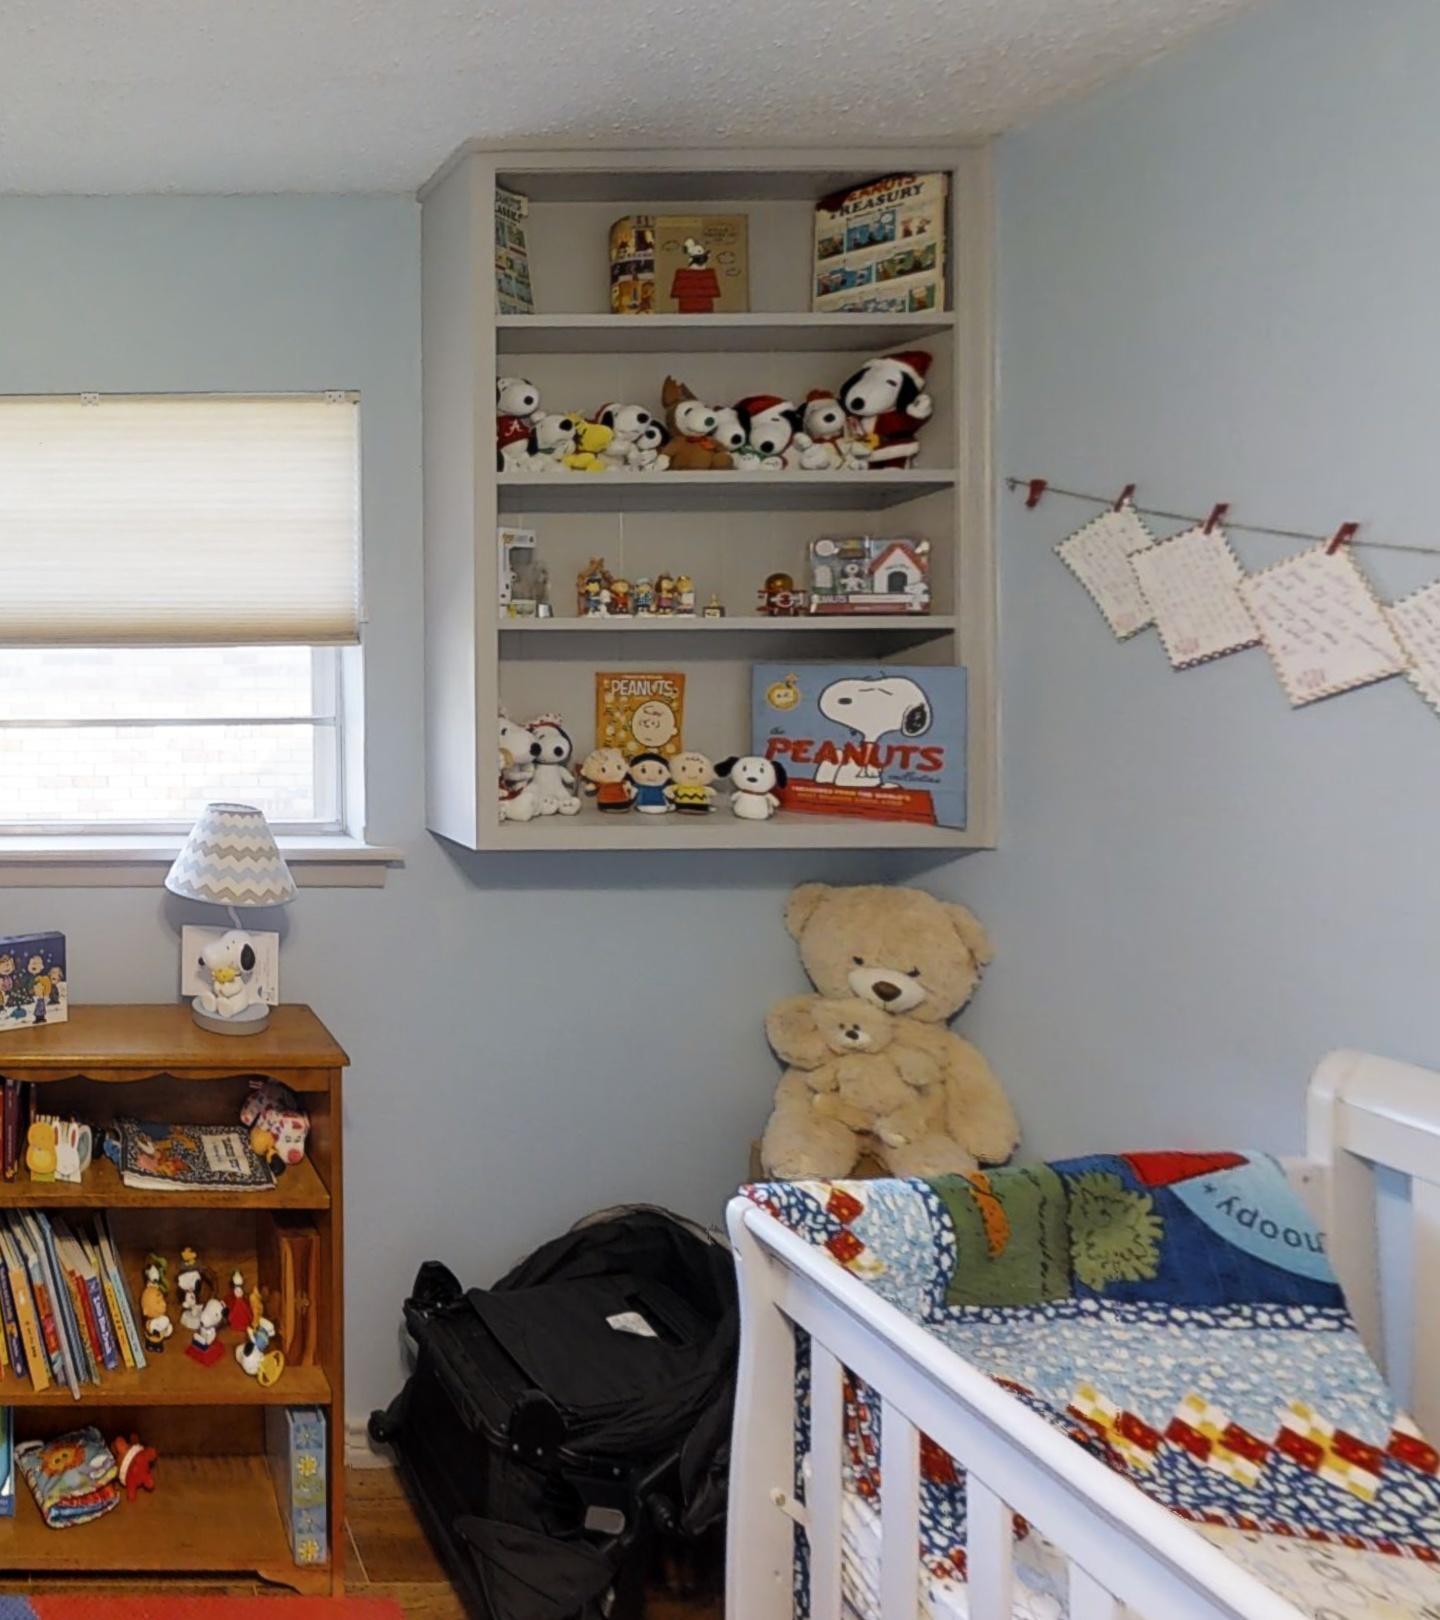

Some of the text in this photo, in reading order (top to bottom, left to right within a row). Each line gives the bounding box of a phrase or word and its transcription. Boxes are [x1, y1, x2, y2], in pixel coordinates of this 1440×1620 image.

[830, 182, 924, 219] REASURY
[848, 175, 916, 201] EANUTS
[612, 680, 674, 697] PEANUTS
[764, 736, 945, 772] PEANUTS
